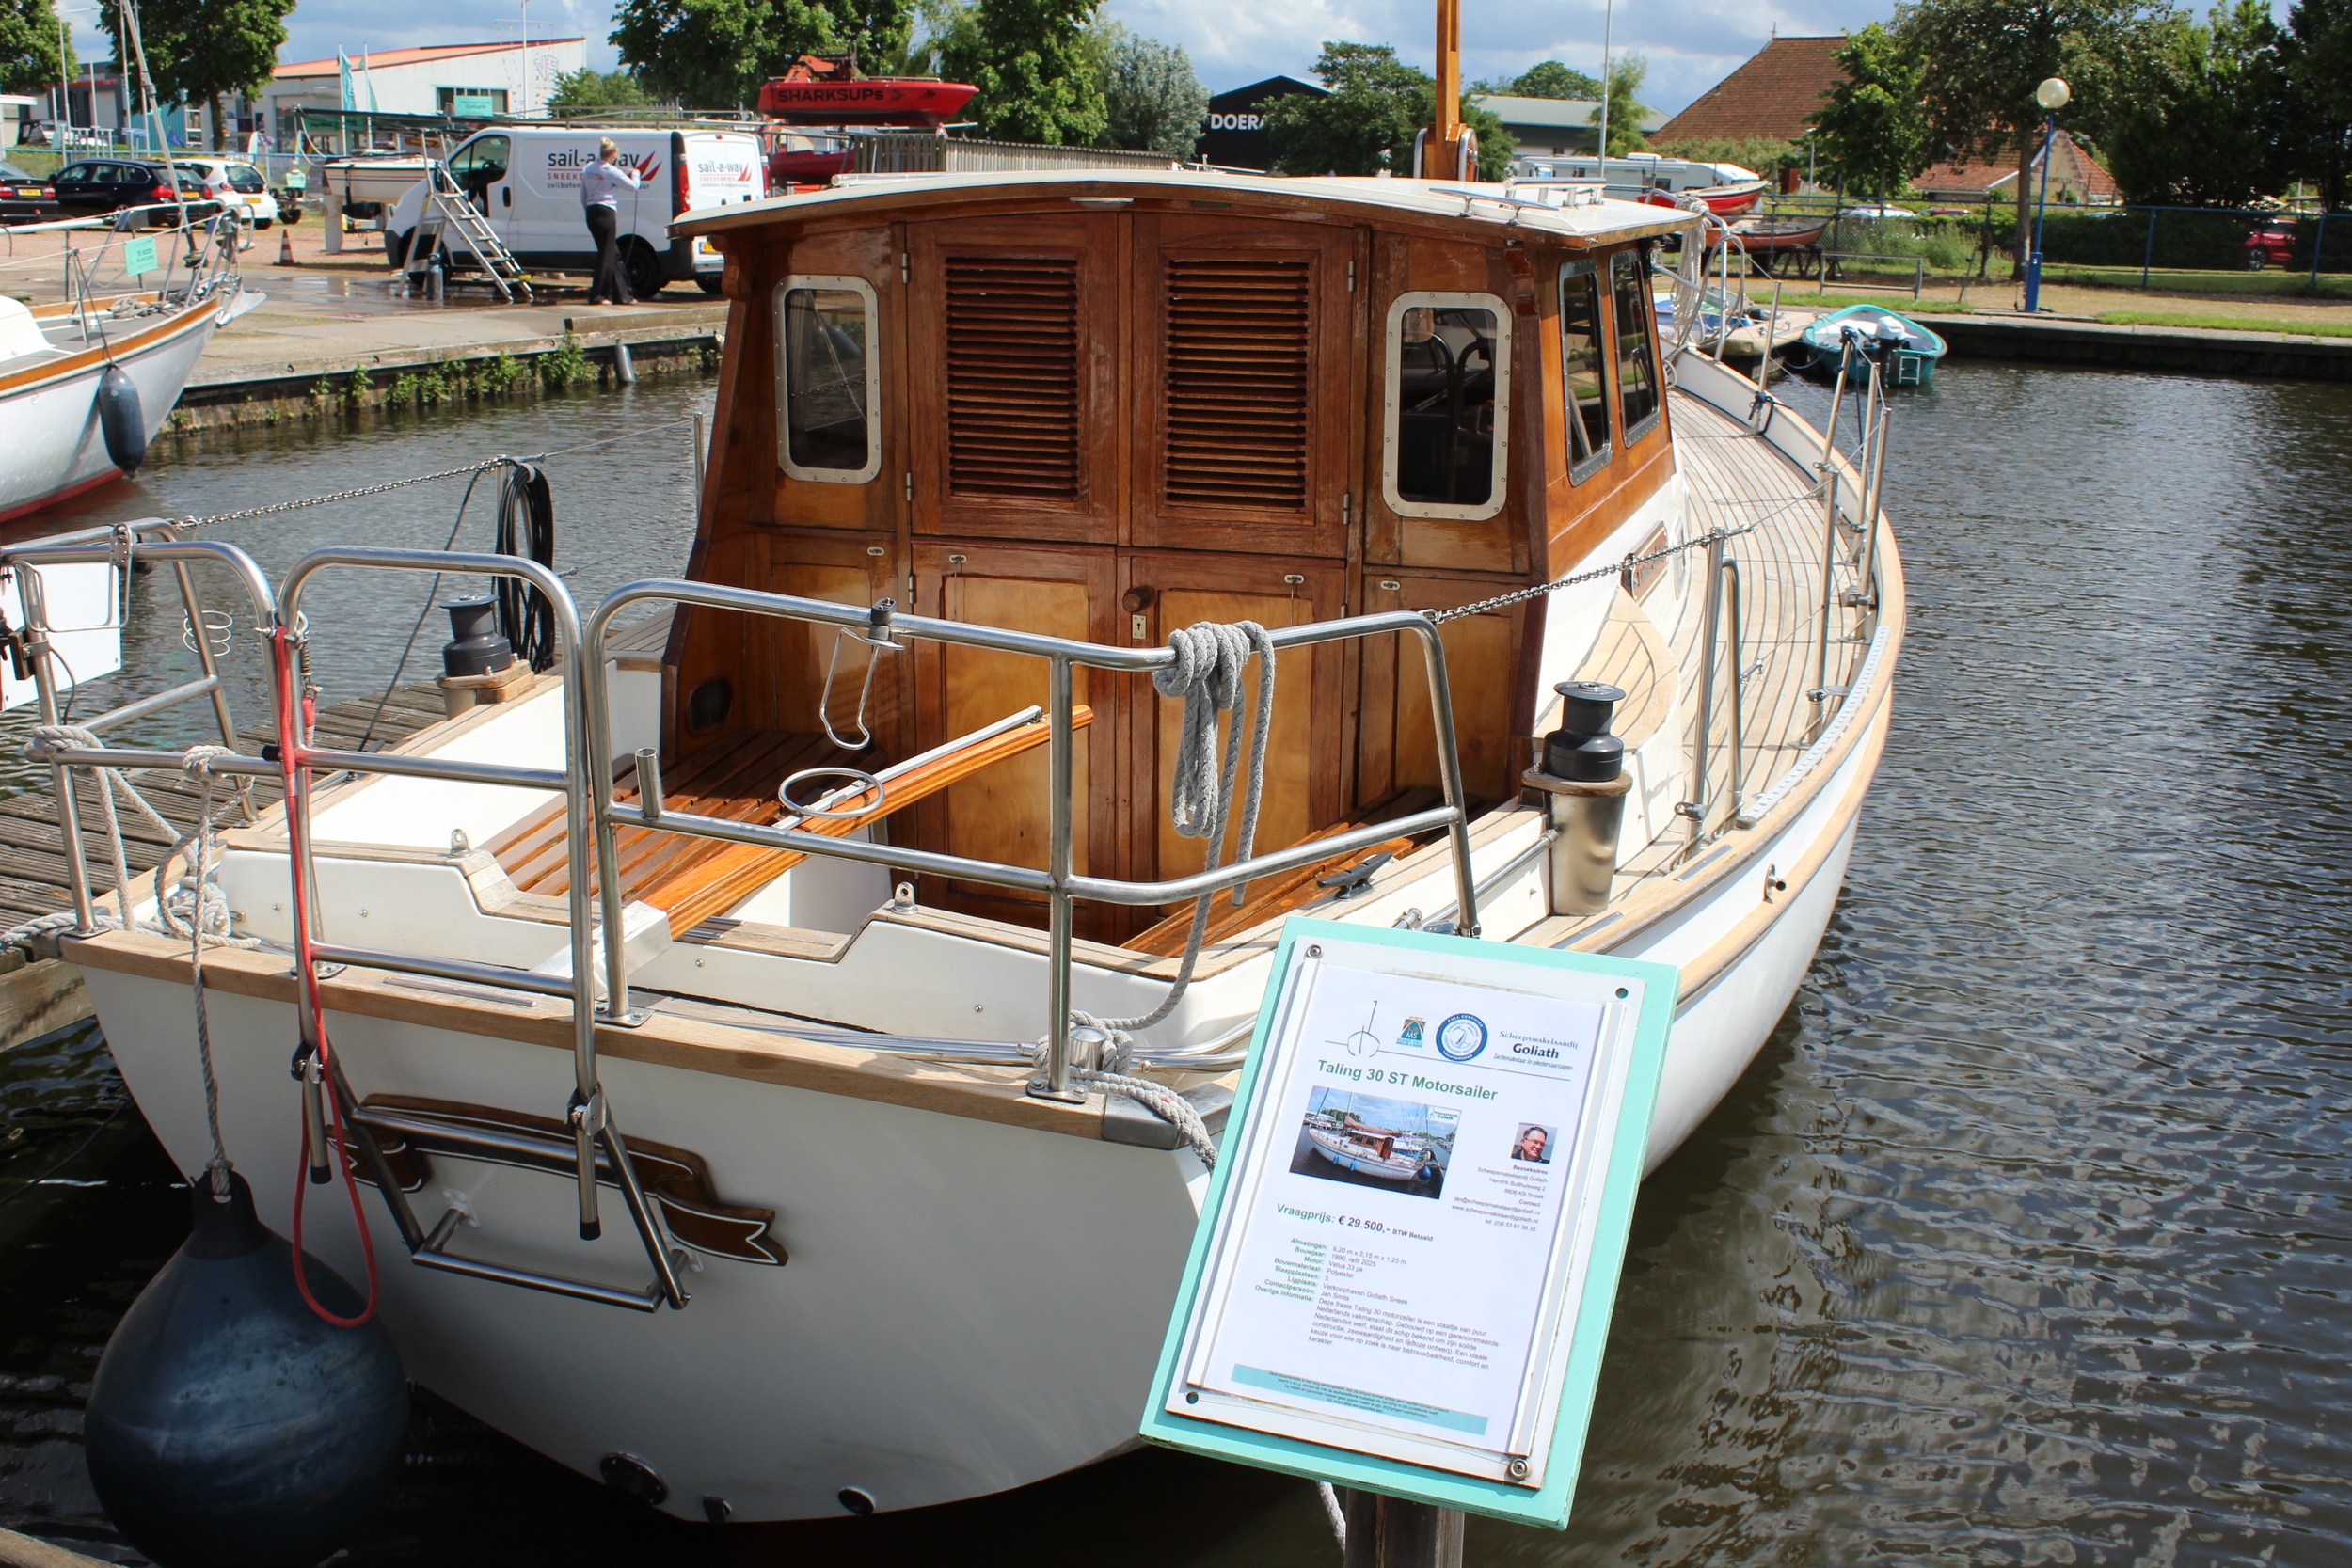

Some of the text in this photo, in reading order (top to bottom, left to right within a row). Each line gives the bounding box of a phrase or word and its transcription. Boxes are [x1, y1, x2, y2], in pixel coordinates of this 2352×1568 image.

[777, 88, 884, 102] SHARKSUPs
[698, 160, 743, 174] sail-a-way
[1513, 1043, 1558, 1058] Goliath
[1319, 1059, 1497, 1099] Taling 30 ST Motorsailer
[1277, 1203, 1334, 1223] Vraagprijs:
[1338, 1215, 1344, 1224] €
[1347, 1217, 1390, 1232] 29.500,-
[1408, 1231, 1433, 1241] Betaald
[1290, 1238, 1327, 1249] Afmetingen:
[1359, 1250, 1372, 1259] 3,15
[1295, 1245, 1326, 1257] Bouwjaar:
[1304, 1256, 1323, 1264] Motor:
[1274, 1257, 1354, 1277] Bouwmateriaal: Polyester
[1274, 1265, 1319, 1278] Slaapplaatsen:
[1264, 1278, 1315, 1295] Contactpersoon:
[1332, 1292, 1349, 1301] Smits
[1287, 1275, 1407, 1304] Ligplaats: Verkoophaven Goliath Sneek
[1255, 1284, 1279, 1294] Overige
[1280, 1290, 1313, 1301] informatie:
[1317, 1297, 1334, 1307] Deze
[1335, 1301, 1352, 1310] fraaie
[1354, 1304, 1372, 1314] Taling
[1382, 1311, 1415, 1323] motorzeiler
[1437, 1322, 1457, 1331] staaltje
[1314, 1312, 1351, 1324] Nederlandse
[1369, 1324, 1384, 1333] staat
[1411, 1332, 1434, 1341] bekend
[1457, 1342, 1476, 1353] solide
[1316, 1305, 1349, 1316] Nederlands
[1395, 1321, 1424, 1331] Gebouwd
[1448, 1333, 1498, 1346] gerenommeerde
[1310, 1327, 1327, 1336] keuze
[1456, 1358, 1479, 1367] comfort
[1347, 1328, 1394, 1341] zeewaardigheid
[1405, 1339, 1425, 1348] tijdloze
[1469, 1352, 1487, 1360] ideale
